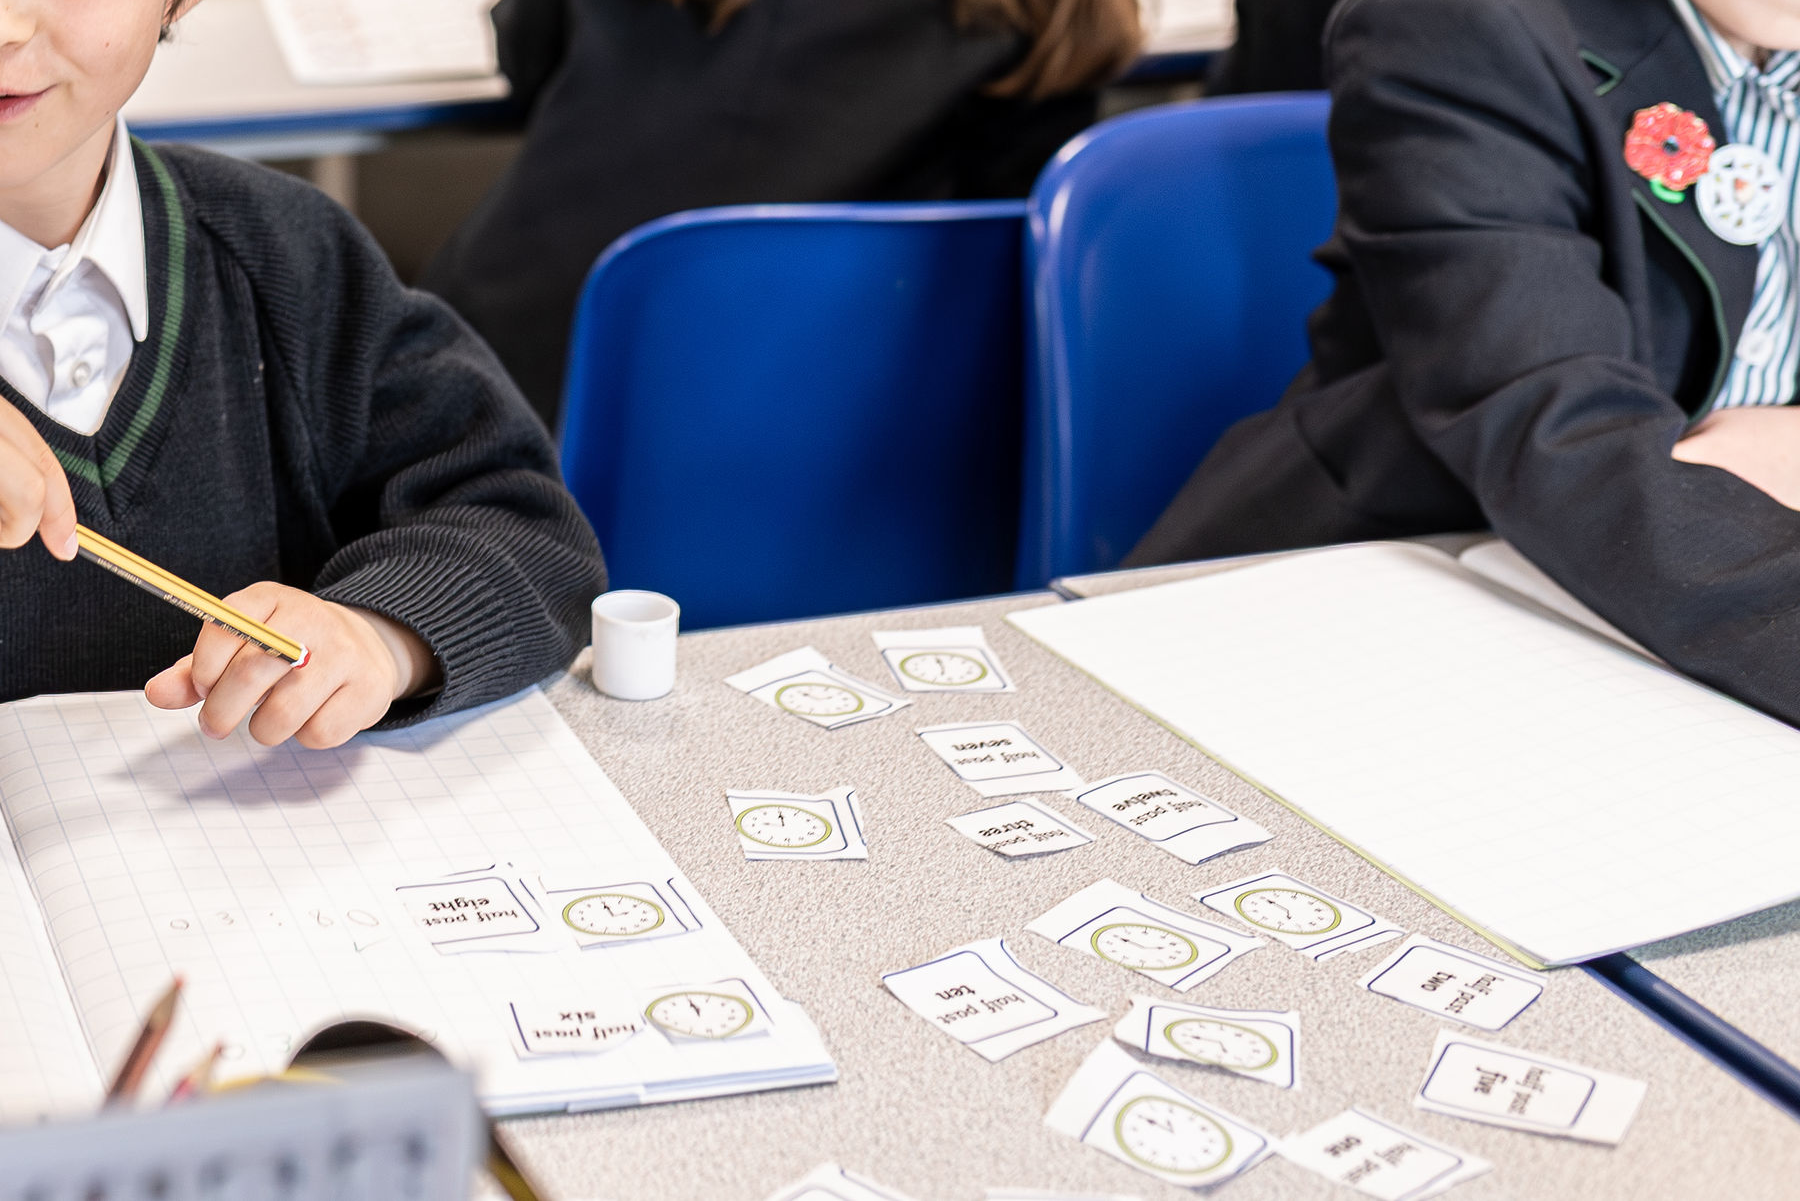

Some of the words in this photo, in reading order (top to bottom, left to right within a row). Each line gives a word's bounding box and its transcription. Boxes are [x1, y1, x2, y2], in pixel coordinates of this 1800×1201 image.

[952, 737, 1012, 751] seven
[954, 753, 995, 766] past
[1001, 751, 1040, 764] half
[1112, 788, 1178, 812] twelve
[1174, 800, 1208, 813] half
[1129, 806, 1169, 826] past
[978, 817, 1034, 837] three
[428, 896, 490, 913] eight
[422, 910, 468, 927] past
[477, 908, 518, 925] half
[1421, 970, 1457, 992] two
[1465, 972, 1504, 996] half
[935, 984, 975, 1001] ten
[1444, 989, 1475, 1014] past
[981, 993, 1025, 1014] half
[559, 1010, 596, 1024] six
[937, 1004, 979, 1024] past
[532, 1027, 582, 1039] past
[592, 1023, 636, 1041] half
[1473, 1065, 1508, 1095] five
[1324, 1134, 1362, 1158] one
